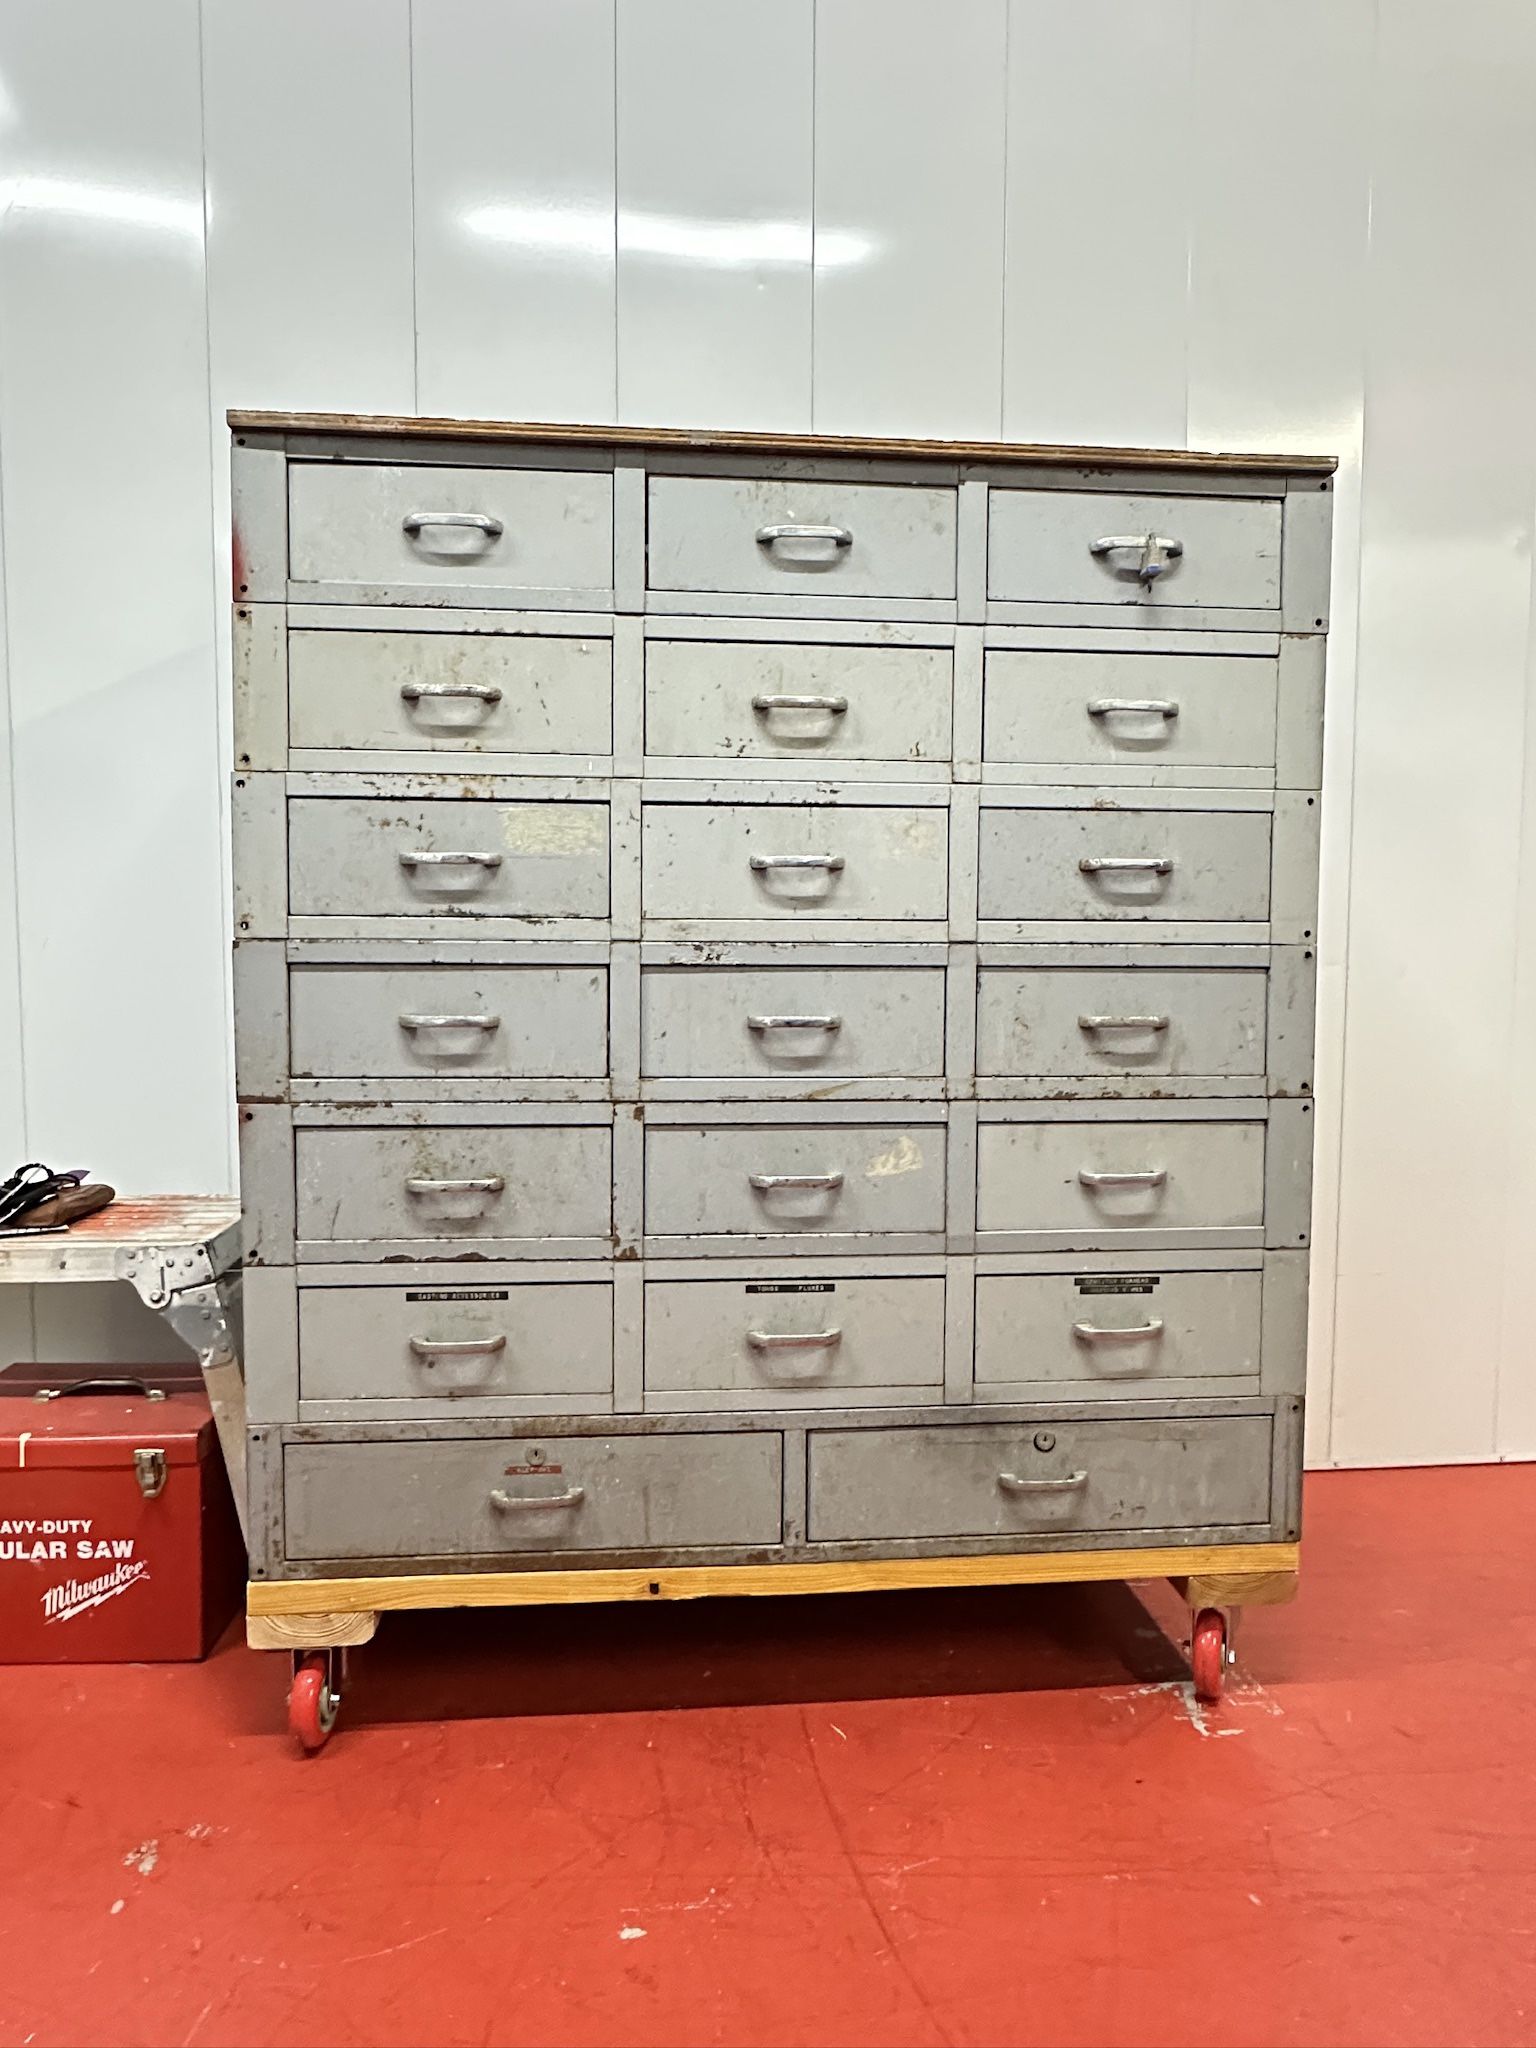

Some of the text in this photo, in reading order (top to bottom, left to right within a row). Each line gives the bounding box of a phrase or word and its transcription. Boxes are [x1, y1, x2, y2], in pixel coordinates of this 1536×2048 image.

[0, 1539, 134, 1560] ULAR SAW
[40, 1560, 146, 1617] Milwaukee
